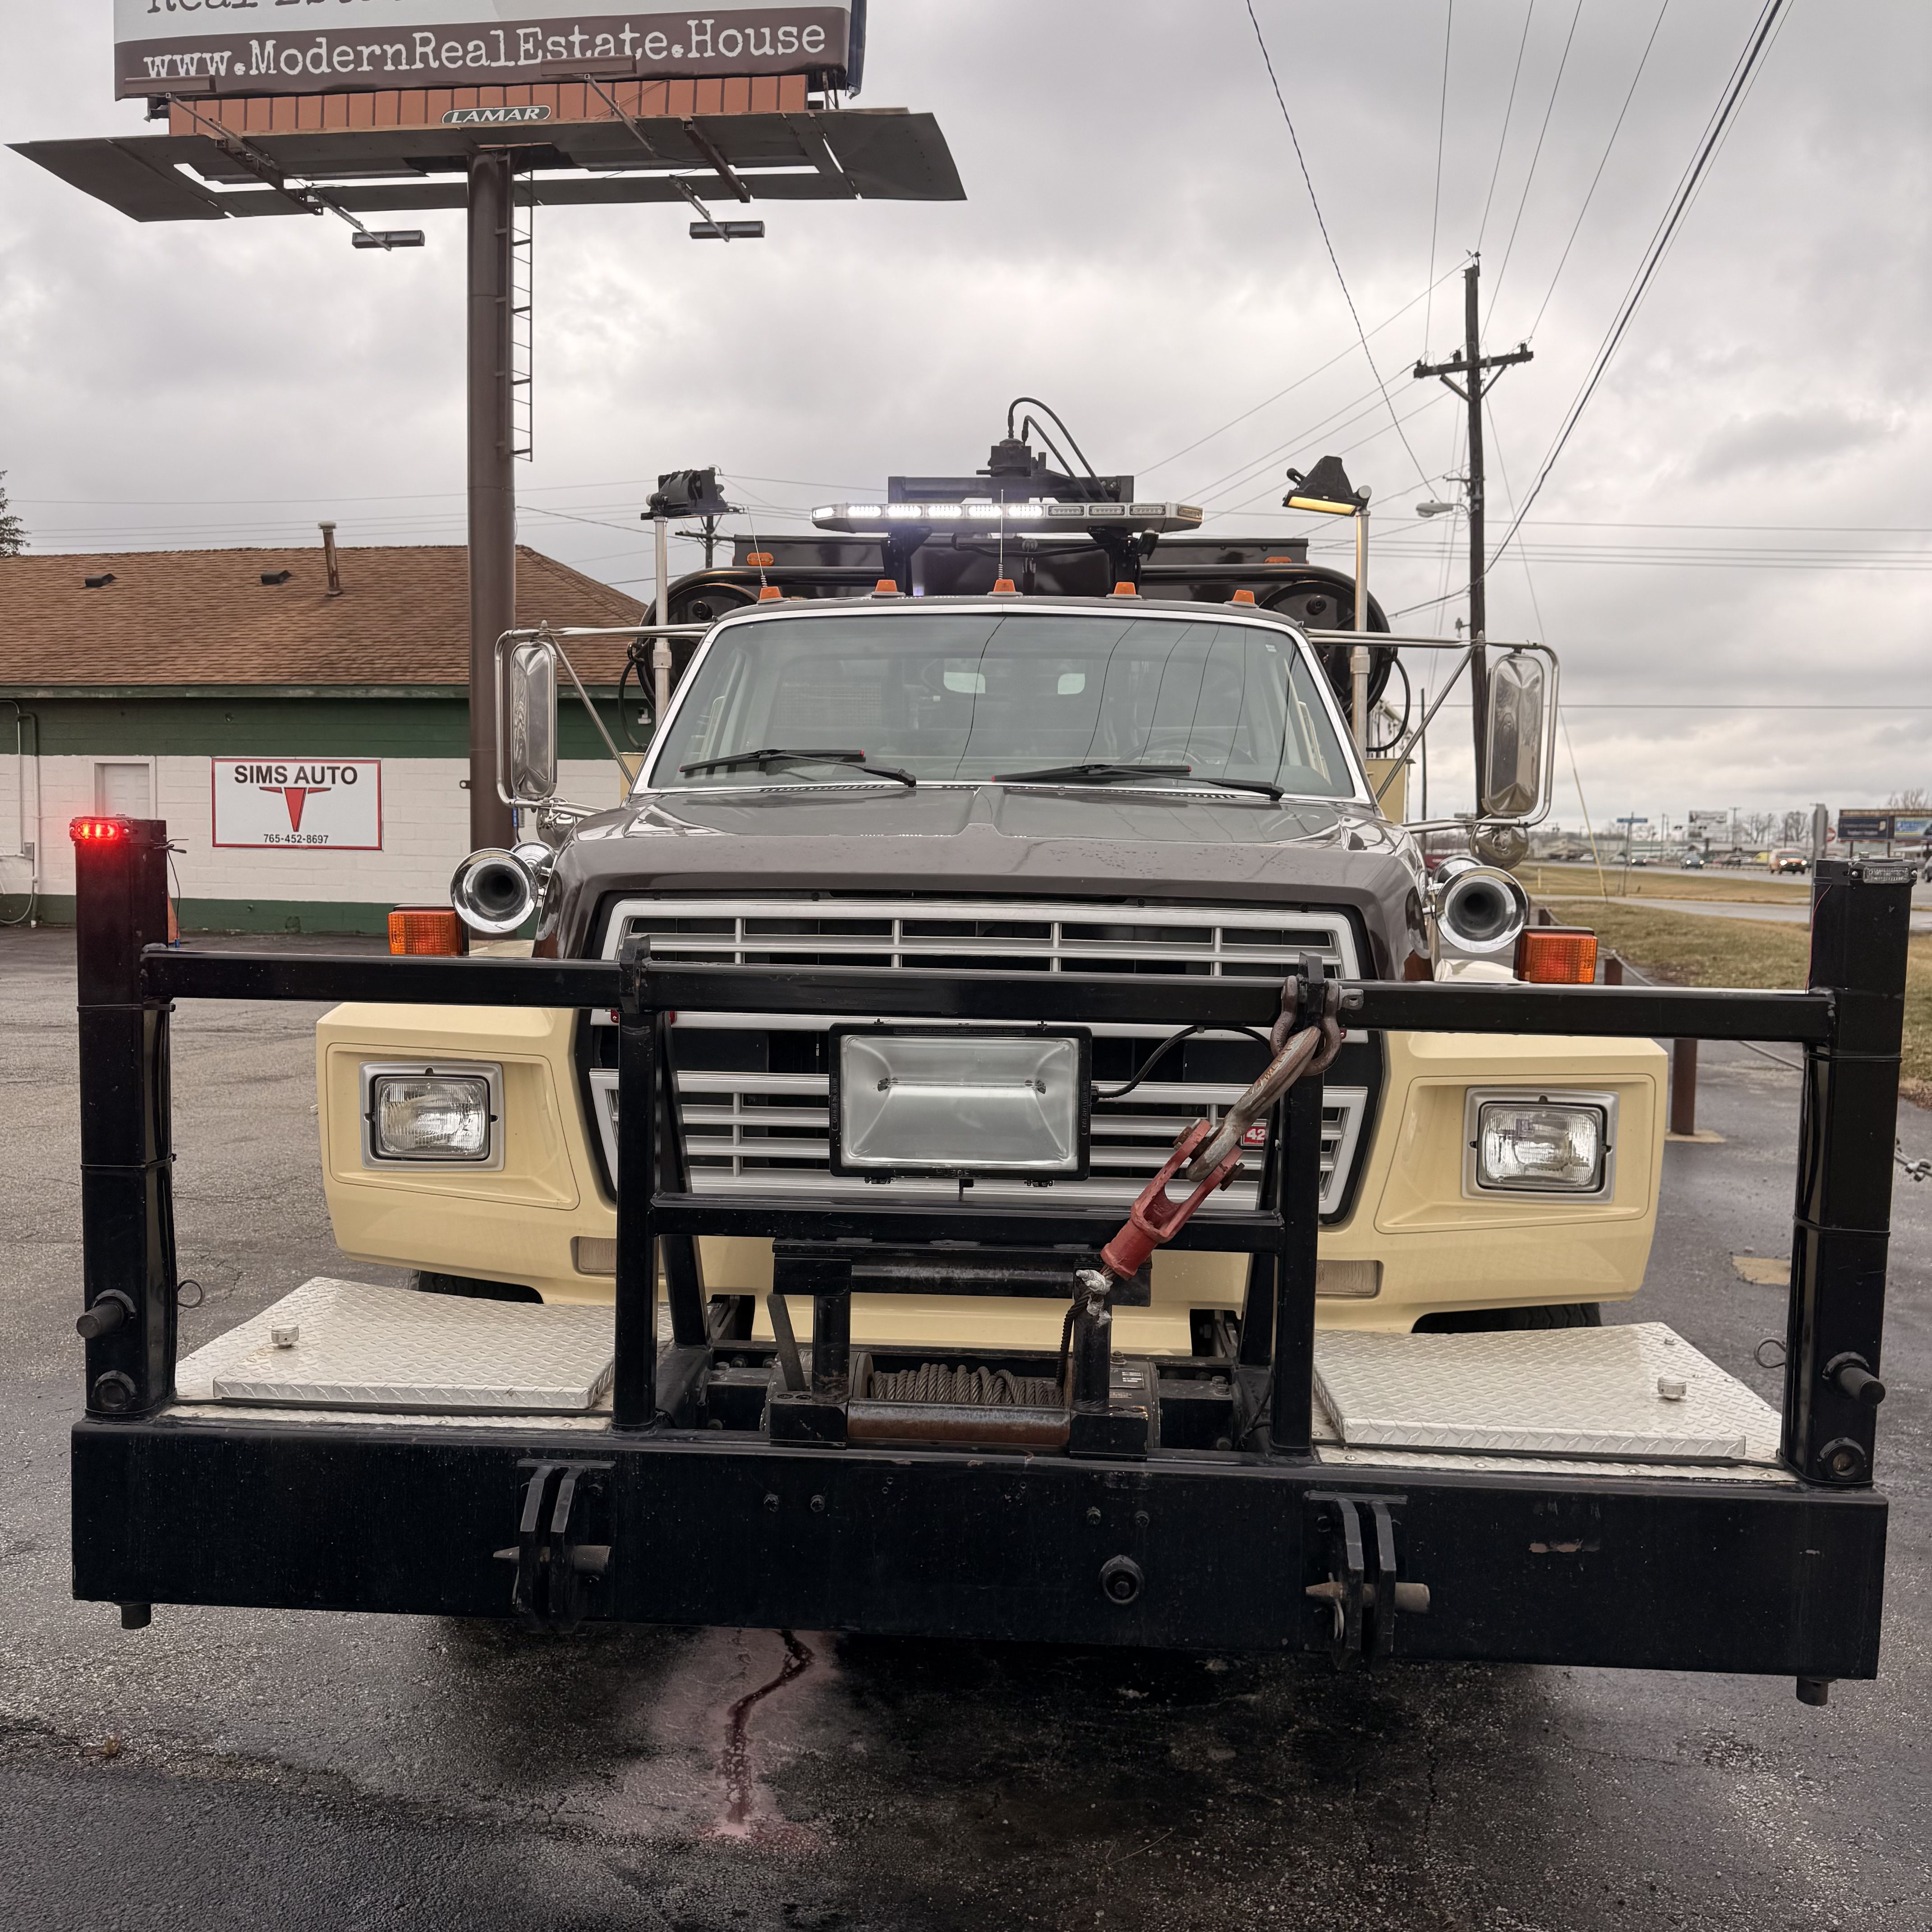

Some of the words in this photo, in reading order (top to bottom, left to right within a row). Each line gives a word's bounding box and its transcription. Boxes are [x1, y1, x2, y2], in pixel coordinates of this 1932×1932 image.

[143, 24, 826, 78] www.ModernRealEstate.House
[451, 108, 540, 123] LAMAR
[234, 765, 288, 784] SIMS
[294, 766, 358, 785] AUTO
[263, 834, 329, 844] 765-452-8697
